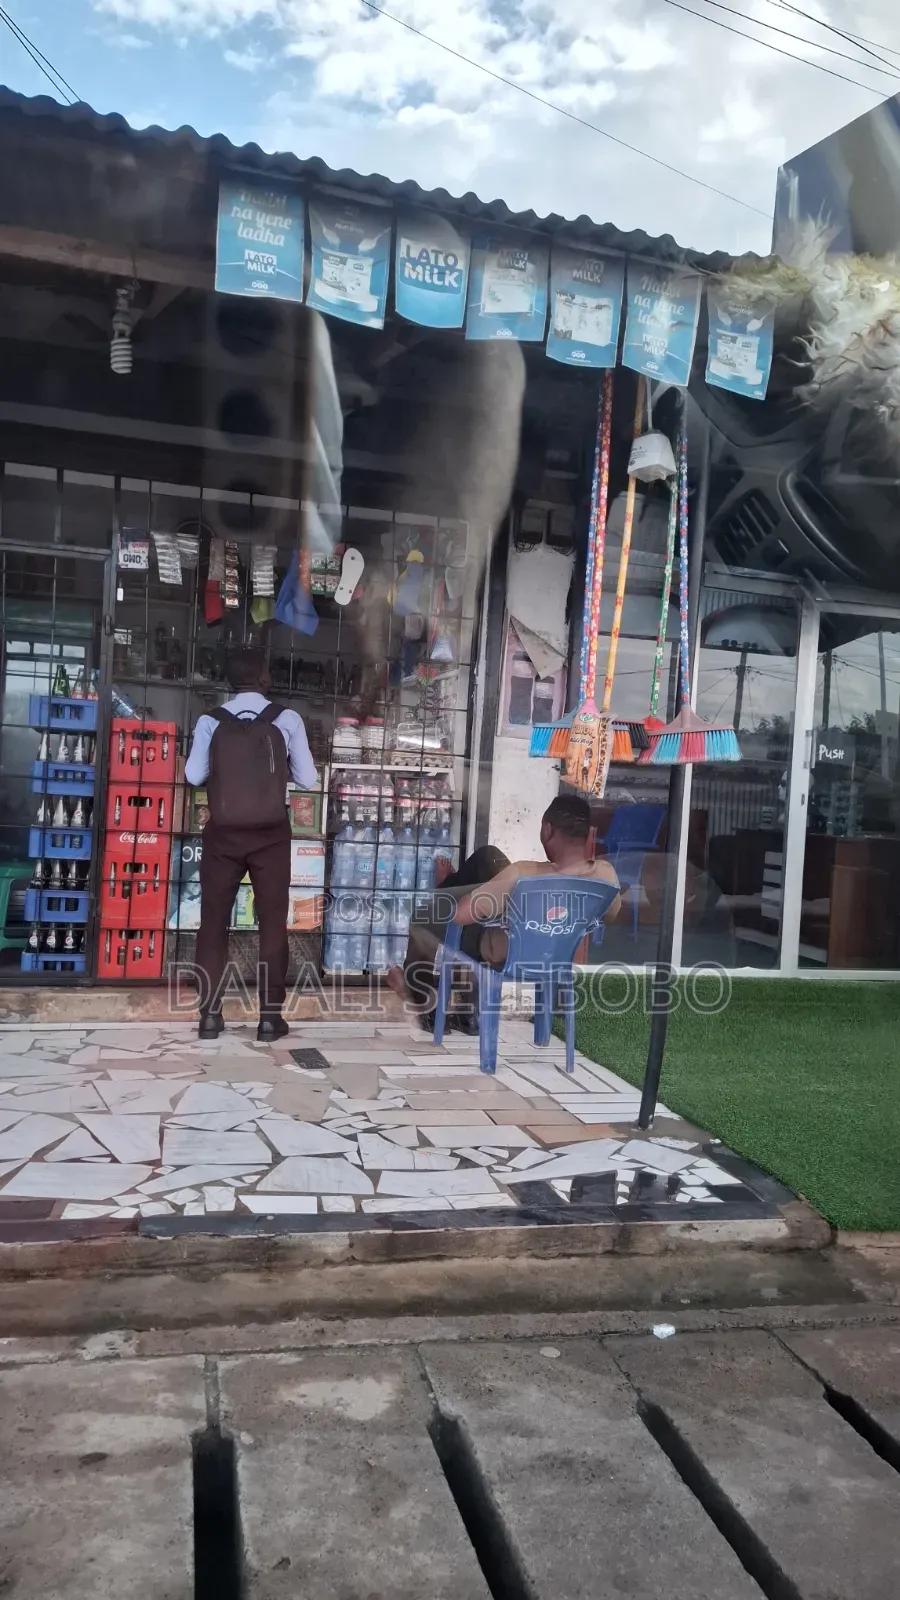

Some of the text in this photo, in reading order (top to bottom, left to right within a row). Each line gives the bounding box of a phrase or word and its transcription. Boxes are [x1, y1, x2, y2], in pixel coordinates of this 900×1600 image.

[231, 205, 252, 221] na
[237, 221, 285, 246] ladha
[247, 252, 274, 265] LATO
[405, 244, 458, 268] LATO
[634, 294, 651, 310] na
